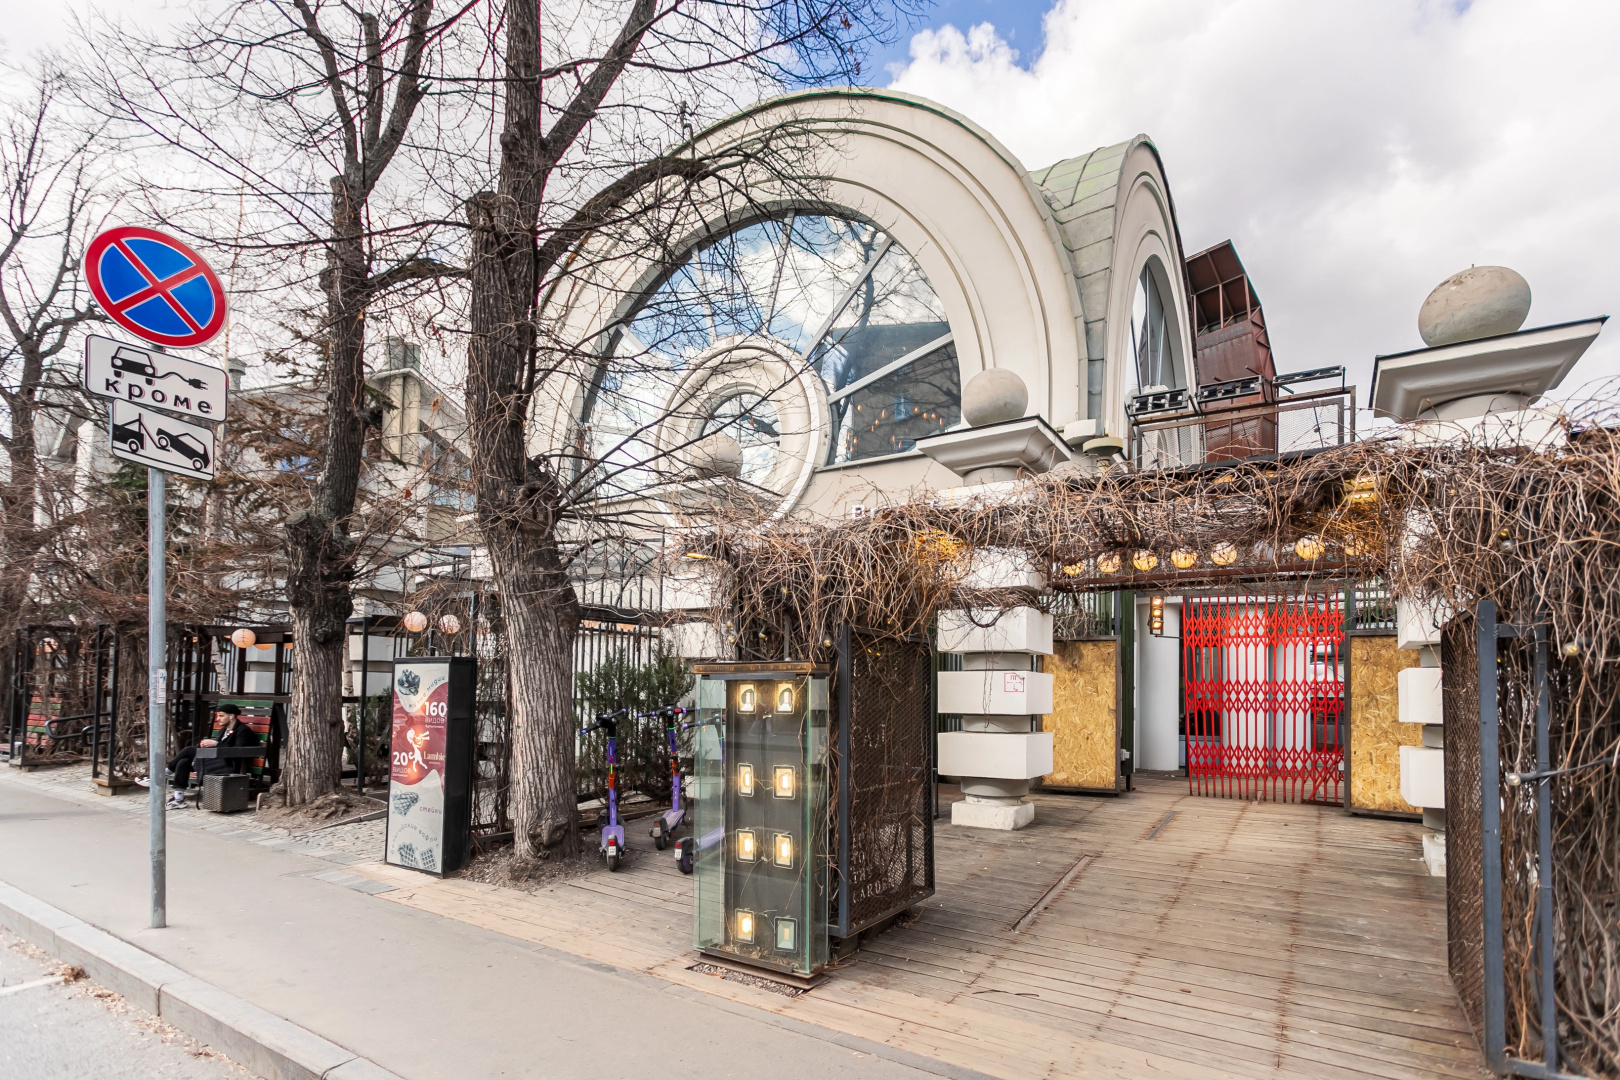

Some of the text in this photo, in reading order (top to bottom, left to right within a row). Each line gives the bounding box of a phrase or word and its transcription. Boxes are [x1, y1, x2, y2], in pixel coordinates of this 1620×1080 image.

[105, 378, 213, 414] кроме
[424, 701, 447, 716] 160
[392, 751, 409, 766] 20
